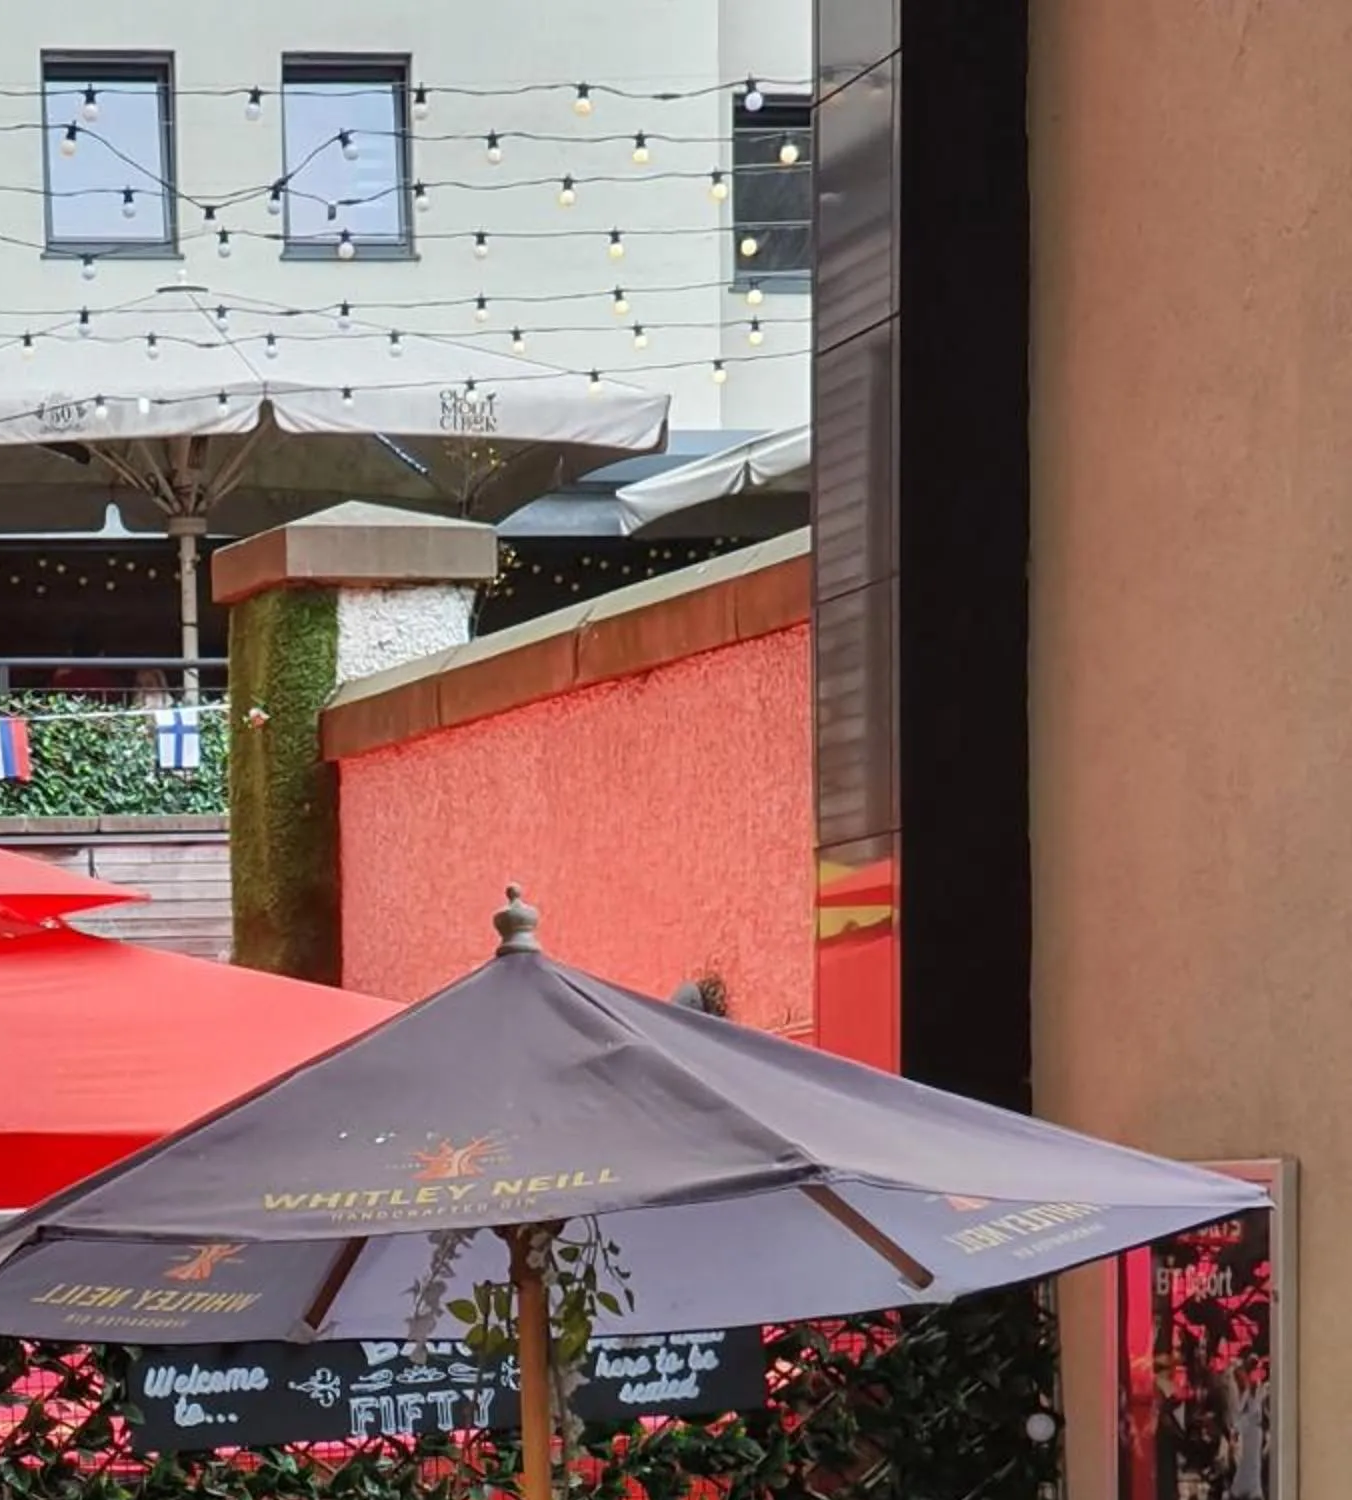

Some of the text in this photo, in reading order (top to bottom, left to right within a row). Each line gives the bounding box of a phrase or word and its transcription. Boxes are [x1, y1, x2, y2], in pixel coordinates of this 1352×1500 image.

[261, 1166, 626, 1212] WHITLEY NEILL
[144, 1363, 270, 1397] Welcome
[350, 1388, 497, 1437] FIFTY
